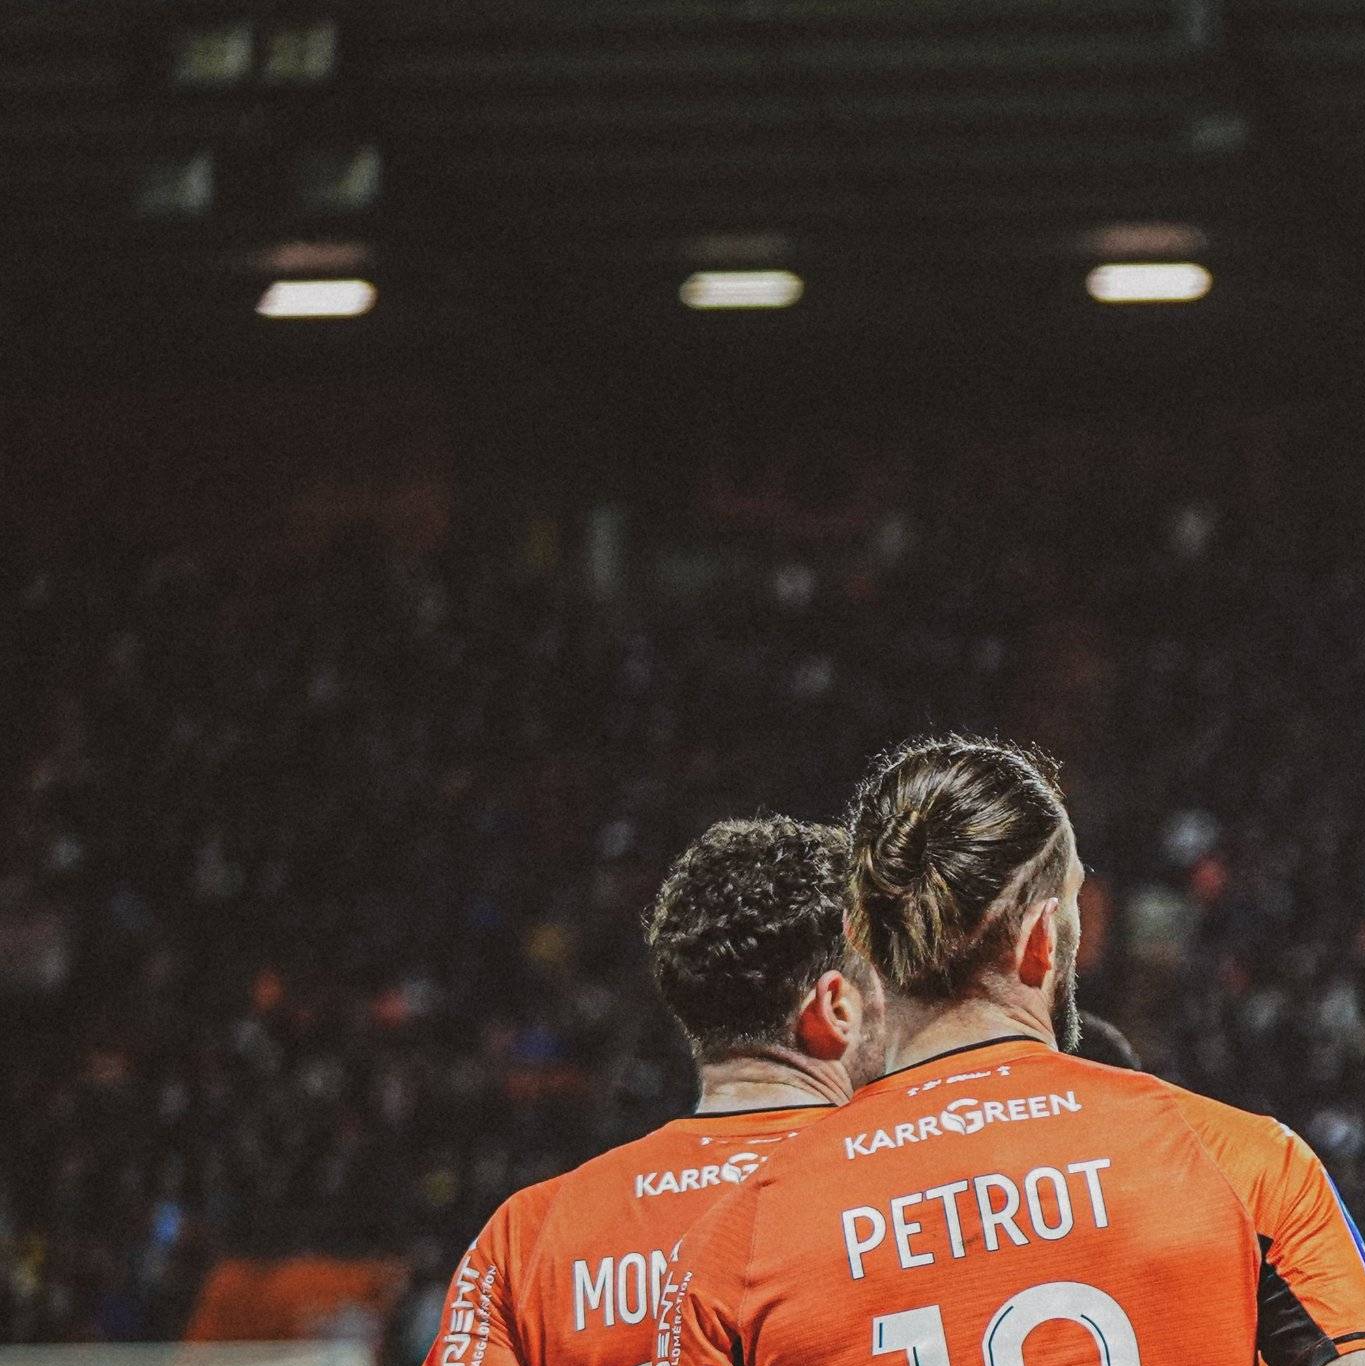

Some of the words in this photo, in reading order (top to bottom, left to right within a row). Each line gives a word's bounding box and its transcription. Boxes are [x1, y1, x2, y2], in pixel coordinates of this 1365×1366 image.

[844, 1091, 1082, 1160] KARRGREEN
[634, 1152, 768, 1198] KARRG
[842, 1158, 1111, 1279] PETROT
